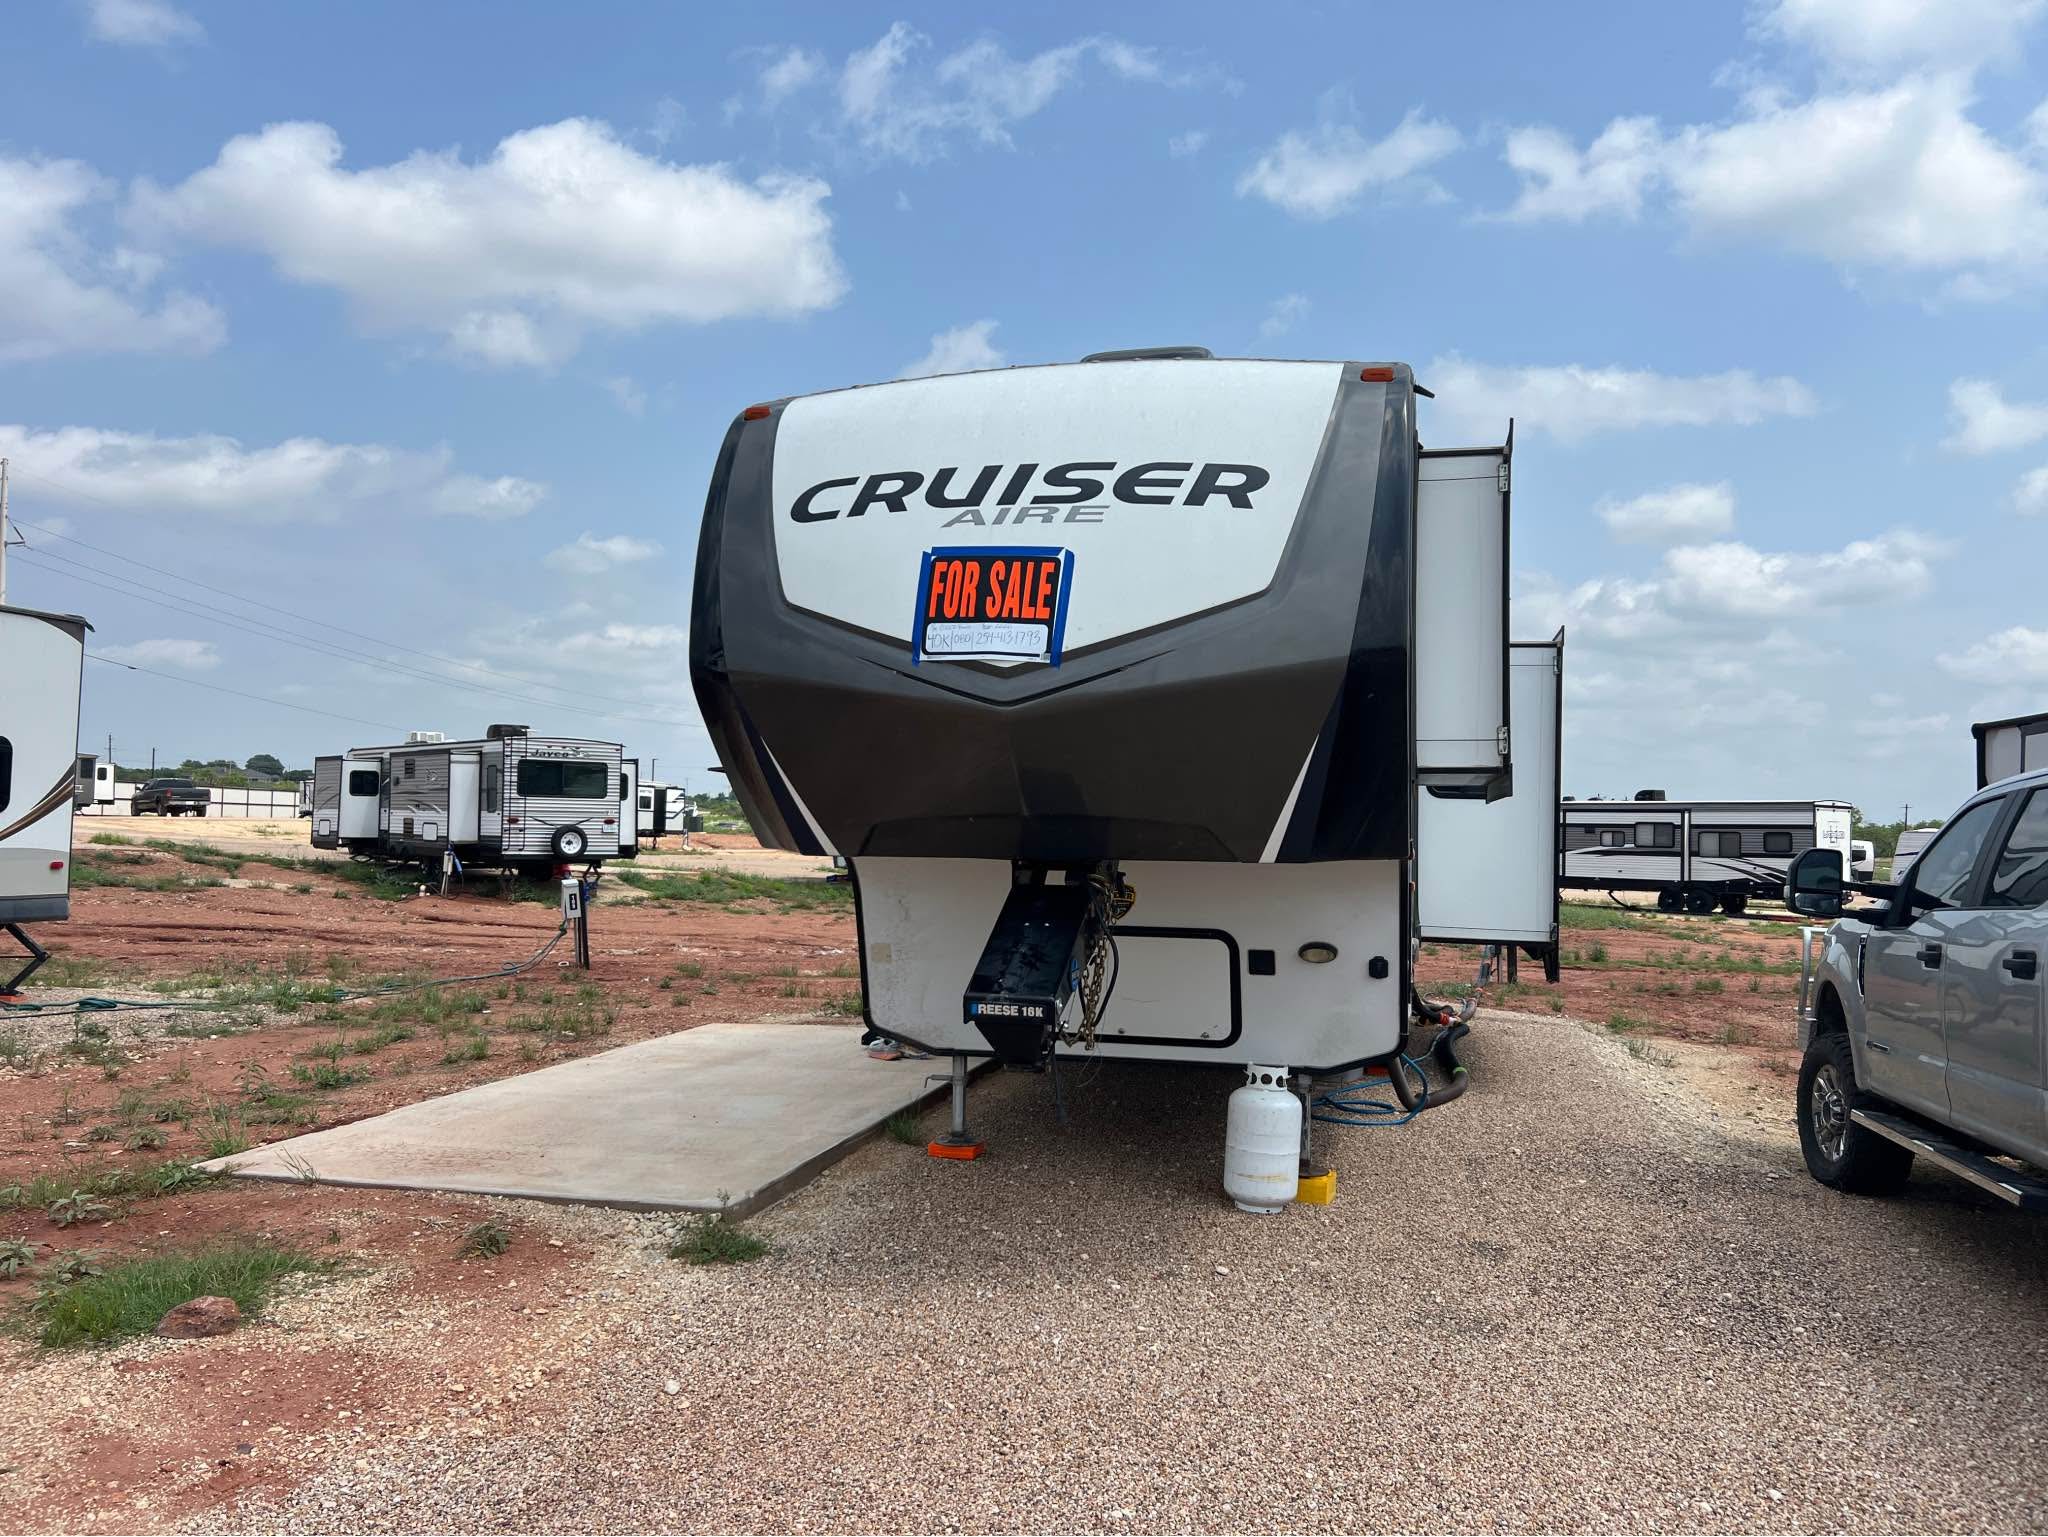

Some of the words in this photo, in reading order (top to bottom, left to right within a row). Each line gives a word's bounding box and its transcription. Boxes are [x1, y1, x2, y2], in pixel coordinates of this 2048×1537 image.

[790, 461, 1270, 523] CRUISER
[940, 505, 1110, 528] AIRE
[929, 560, 980, 619] FOR
[985, 560, 1055, 620] SALE
[531, 749, 569, 758] Jayco
[978, 1003, 1018, 1016] REESE
